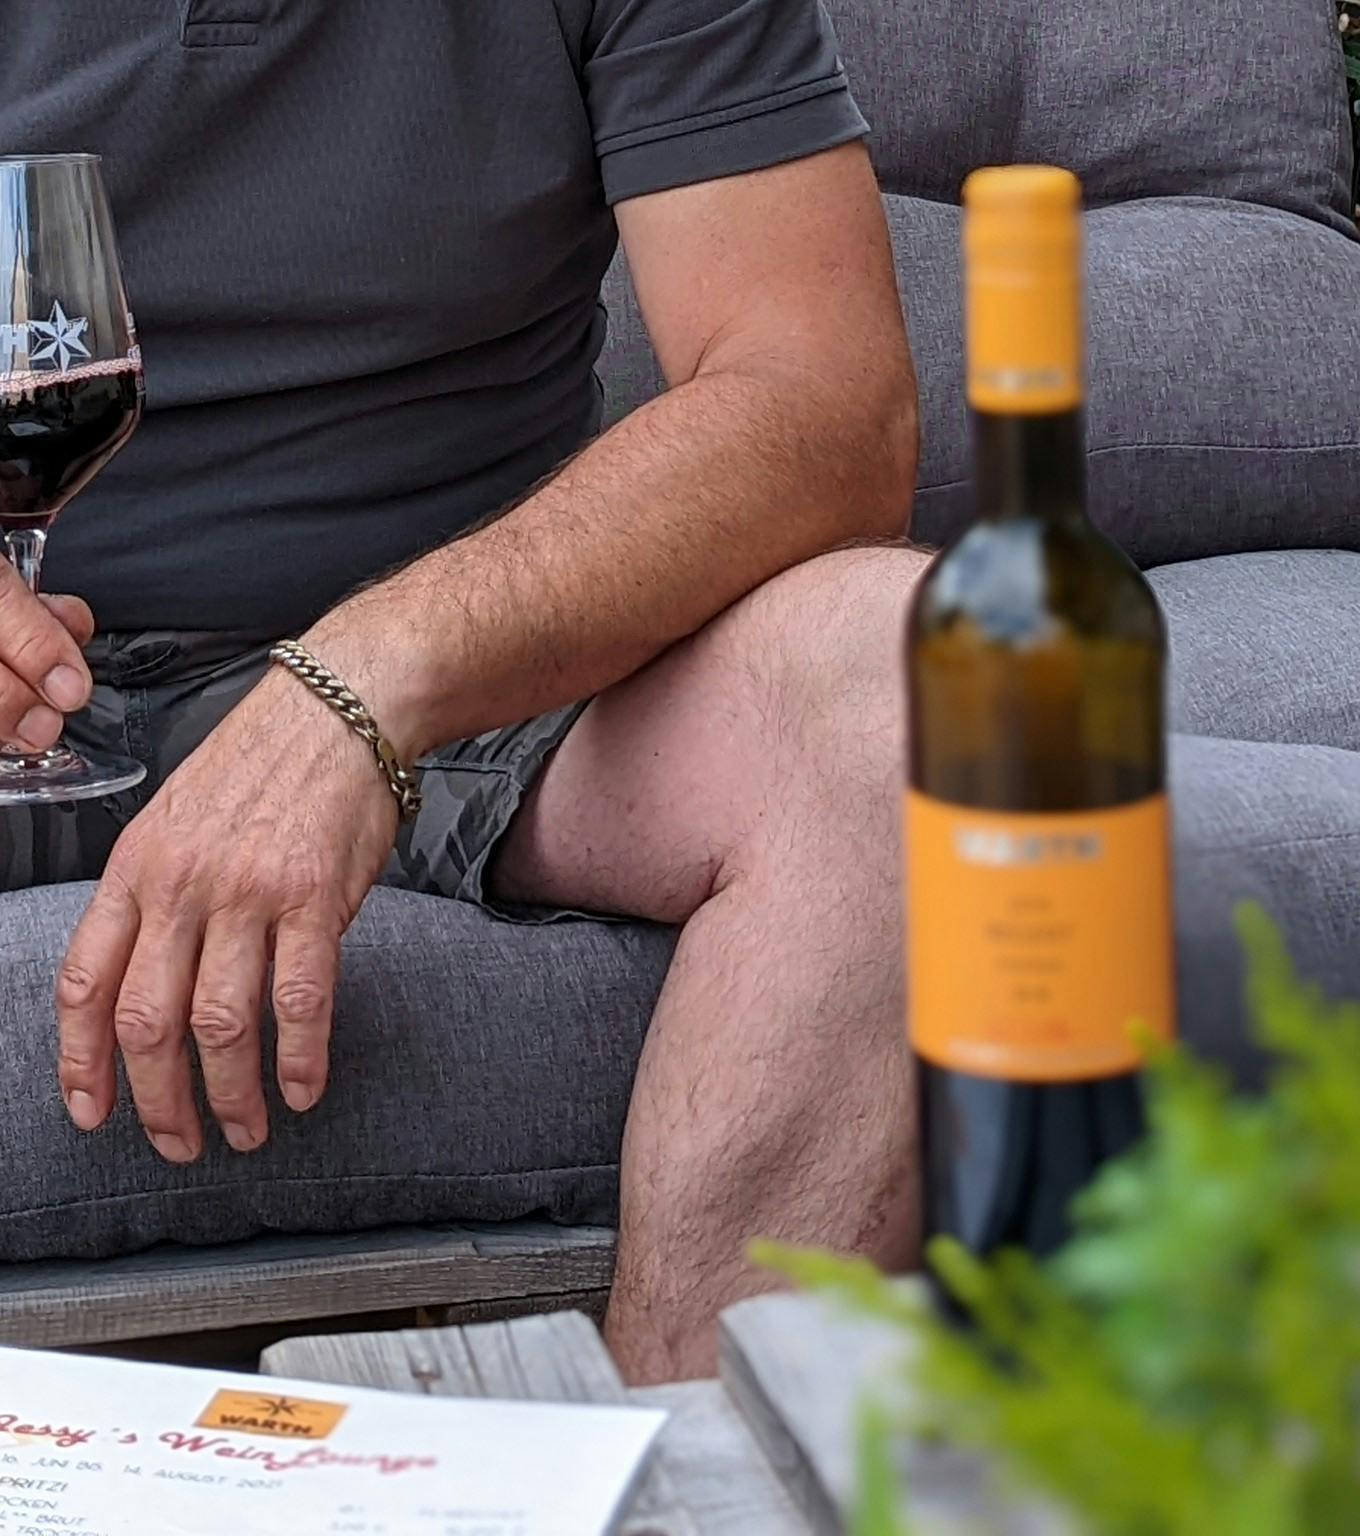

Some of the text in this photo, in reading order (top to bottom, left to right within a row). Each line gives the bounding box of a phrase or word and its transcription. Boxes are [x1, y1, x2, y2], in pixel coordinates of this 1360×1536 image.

[218, 1414, 313, 1435] WARTH
[152, 1468, 230, 1485] AUGUST
[35, 1513, 88, 1527] BRUT
